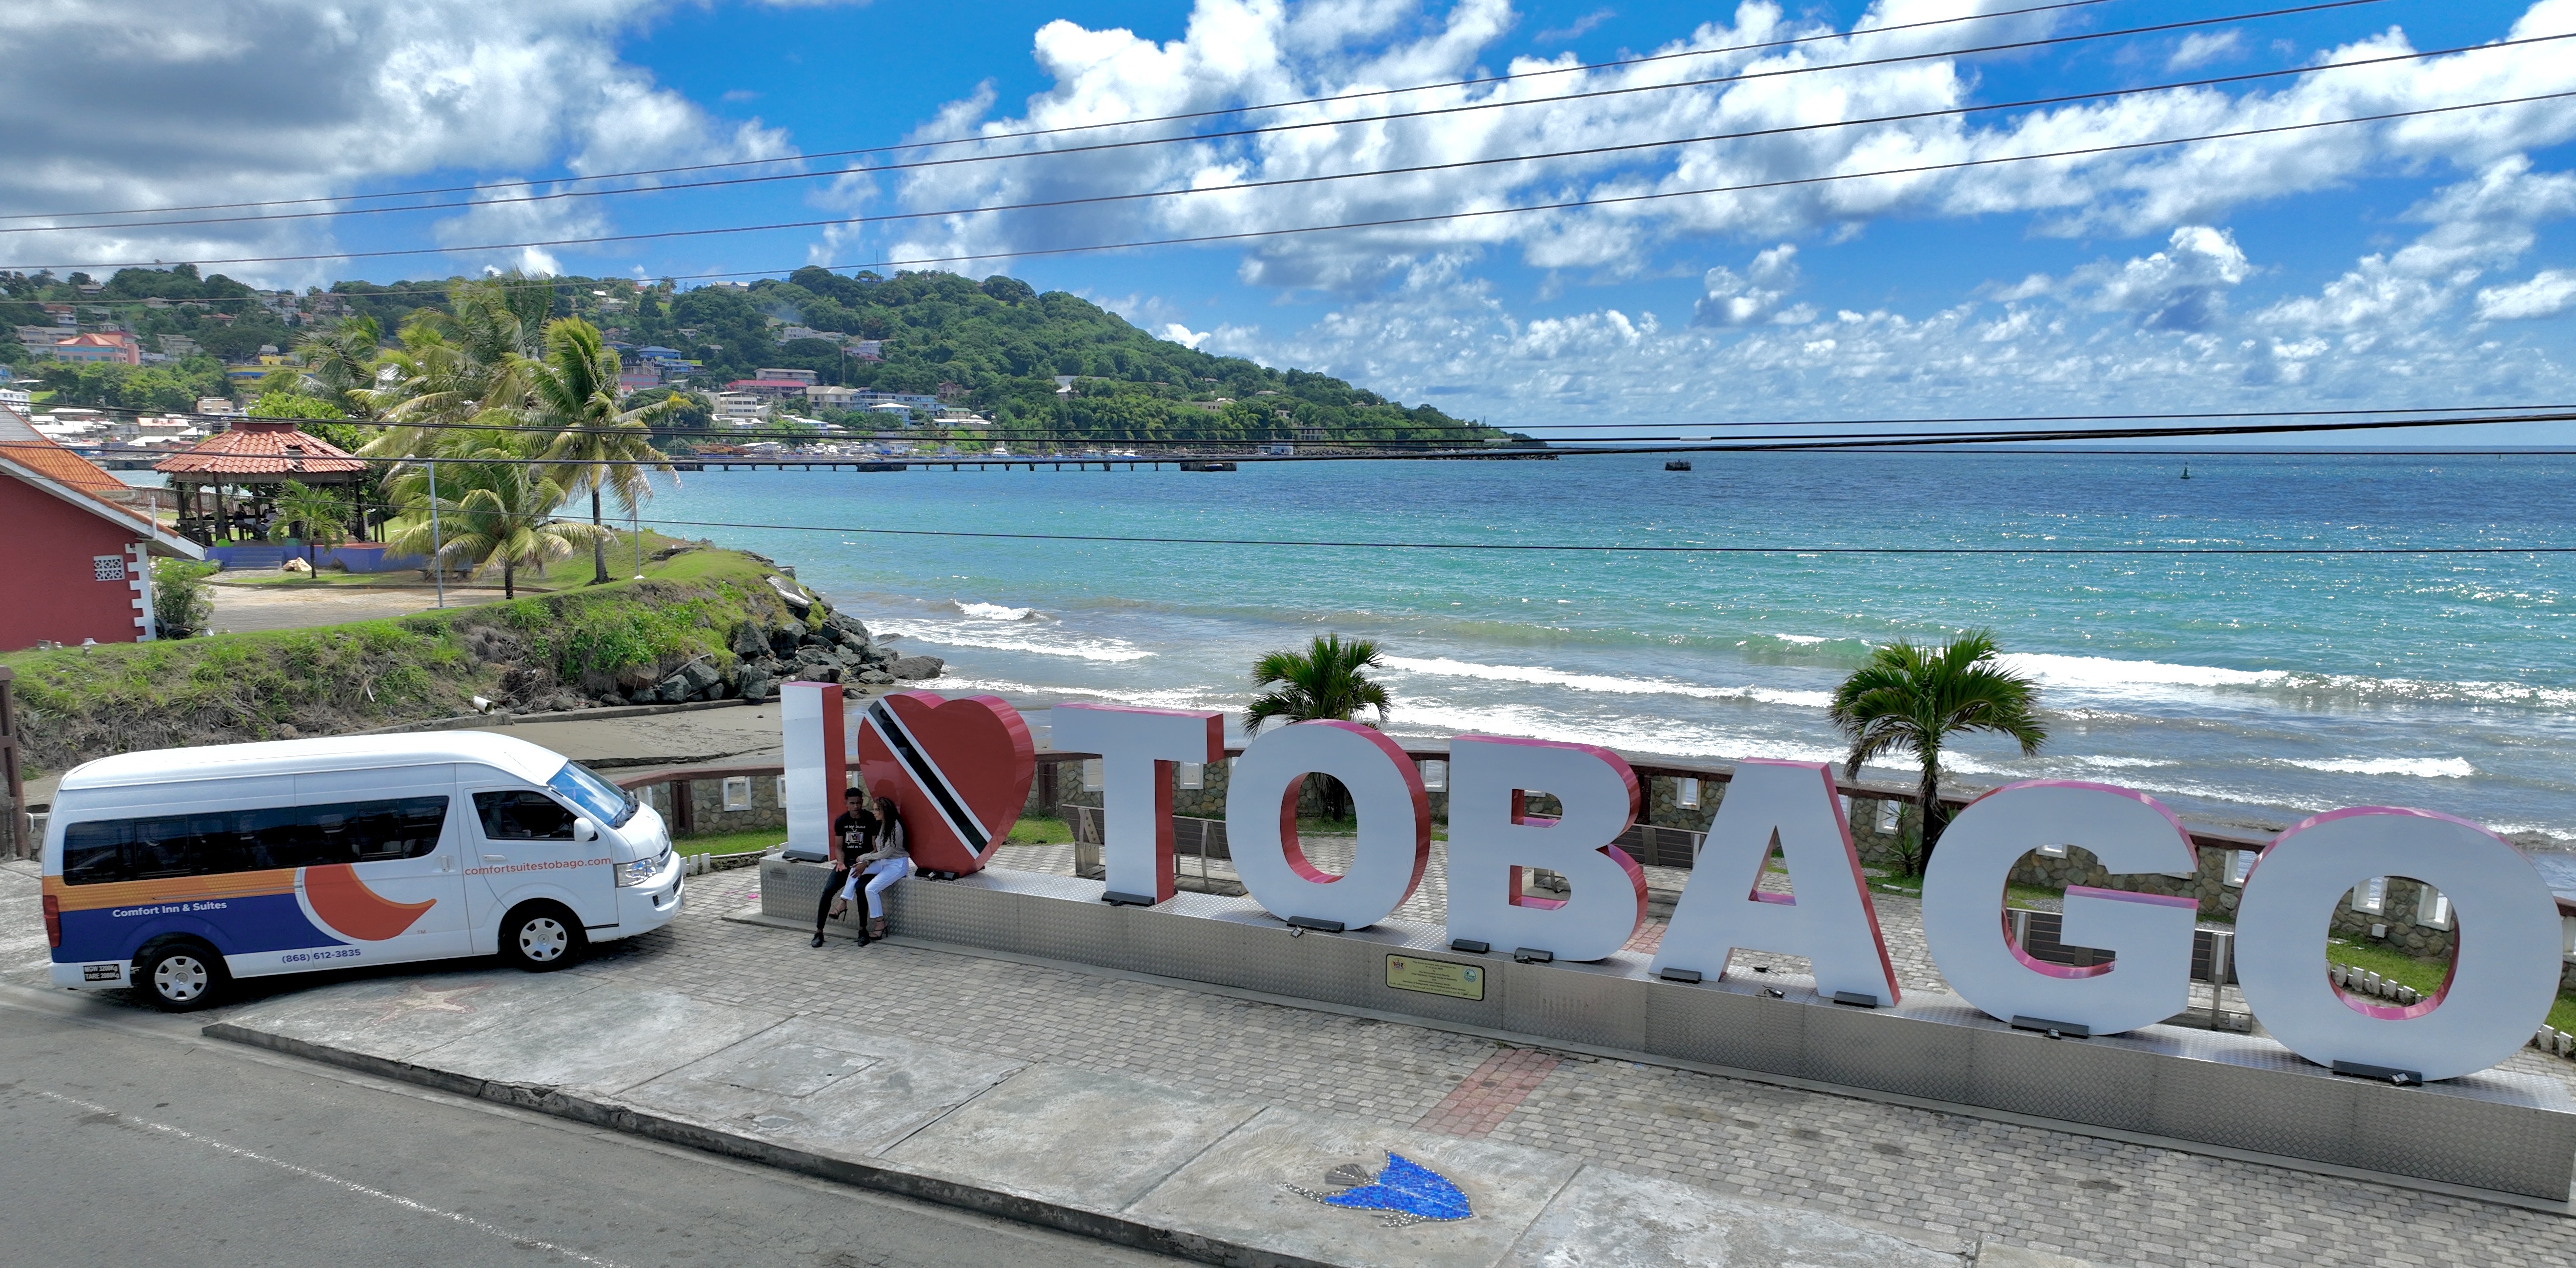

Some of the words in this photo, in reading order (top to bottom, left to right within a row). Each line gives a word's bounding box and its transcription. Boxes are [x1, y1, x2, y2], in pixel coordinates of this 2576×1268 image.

[465, 857, 611, 876] comfortsuitestobago.com
[781, 682, 845, 861] I
[1051, 702, 2562, 1080] TOBAGO
[112, 907, 160, 918] Comfort
[193, 901, 227, 911] Suites
[282, 953, 310, 964] (868)
[313, 949, 361, 960] 612-3835
